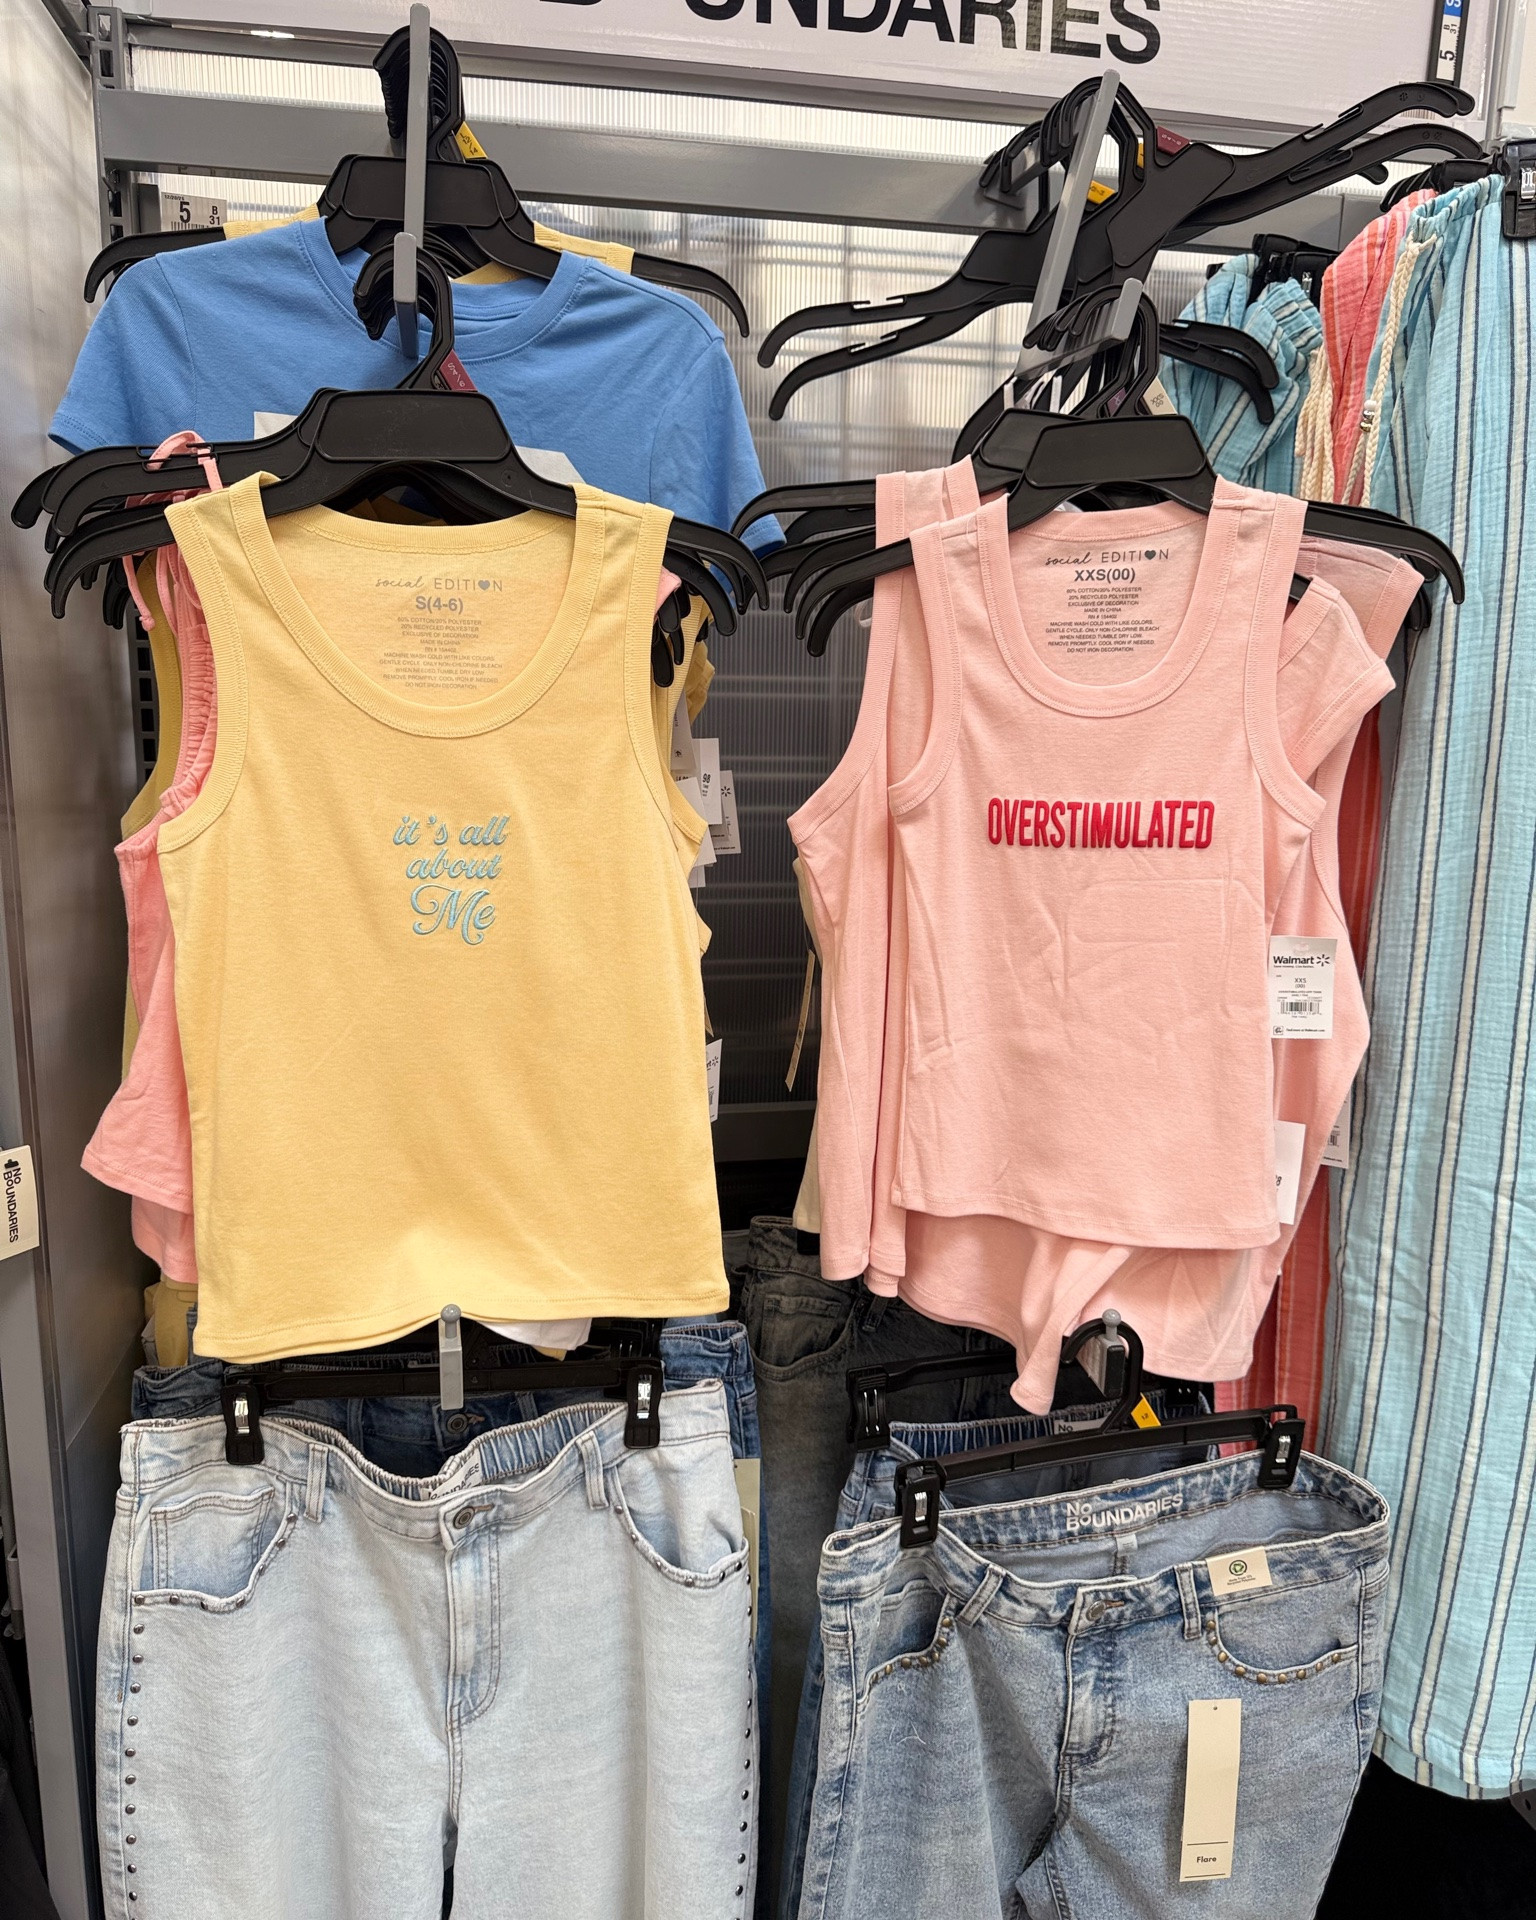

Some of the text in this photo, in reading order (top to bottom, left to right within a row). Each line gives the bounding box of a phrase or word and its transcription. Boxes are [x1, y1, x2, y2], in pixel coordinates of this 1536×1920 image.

[1439, 49, 1455, 61] 5
[179, 200, 191, 224] 5
[211, 205, 219, 216] B
[208, 215, 221, 226] 31
[1045, 551, 1092, 566] social
[375, 575, 425, 589] social
[1074, 567, 1136, 584] XXS(00)
[415, 596, 464, 615] S(4-6)
[393, 815, 511, 846] it's all
[988, 797, 1215, 849] OVERSTIMULATED
[405, 848, 502, 879] about
[410, 883, 496, 946] Me
[1273, 956, 1314, 965] Walmart
[3, 1170, 19, 1243] BOUNDARIES
[1066, 1493, 1184, 1531] BOUNDARIES
[1196, 1855, 1217, 1864] Flare
